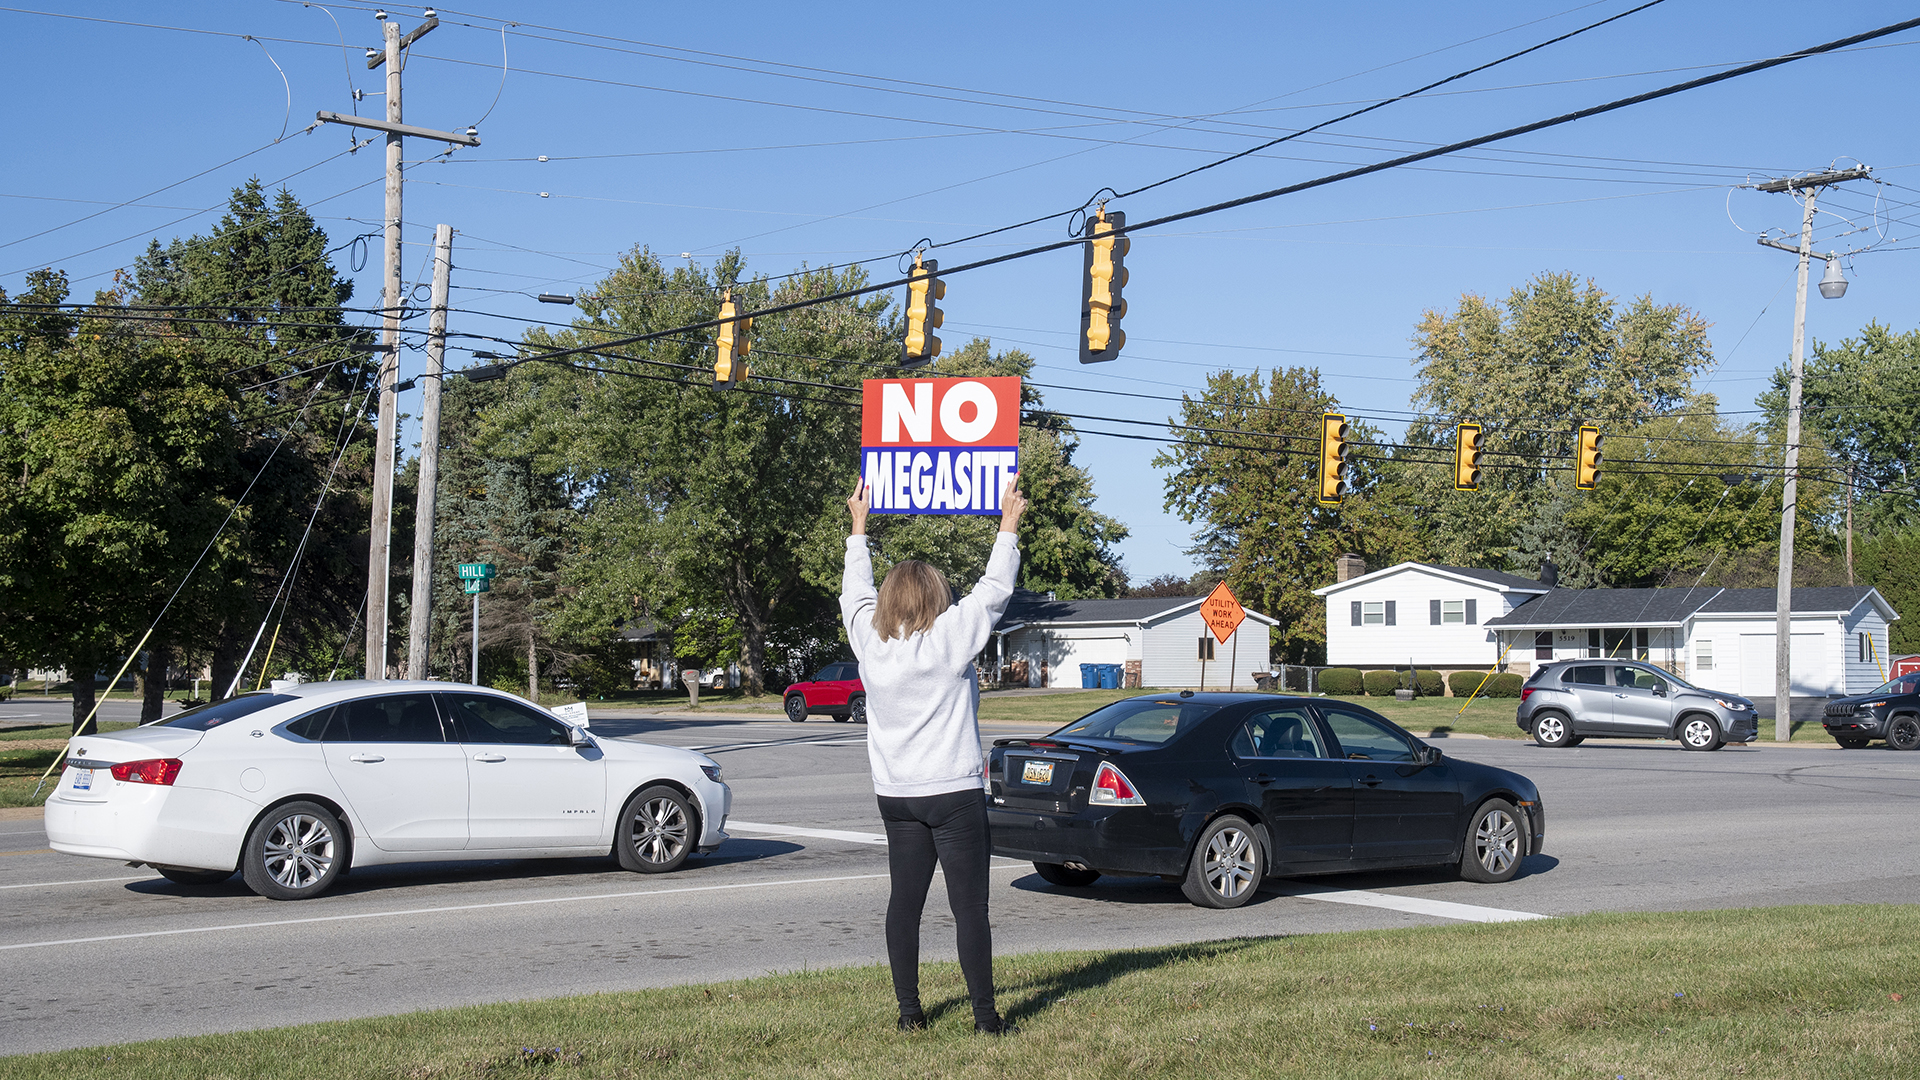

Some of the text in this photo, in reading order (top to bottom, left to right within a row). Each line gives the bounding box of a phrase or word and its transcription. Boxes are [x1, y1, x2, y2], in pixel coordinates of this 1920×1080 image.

[881, 381, 998, 443] NO
[865, 451, 1016, 510] MEGASITE
[462, 566, 484, 577] HILL
[1210, 598, 1235, 608] UTILITY
[1213, 609, 1232, 618] WORK
[1211, 619, 1234, 629] AHEAD
